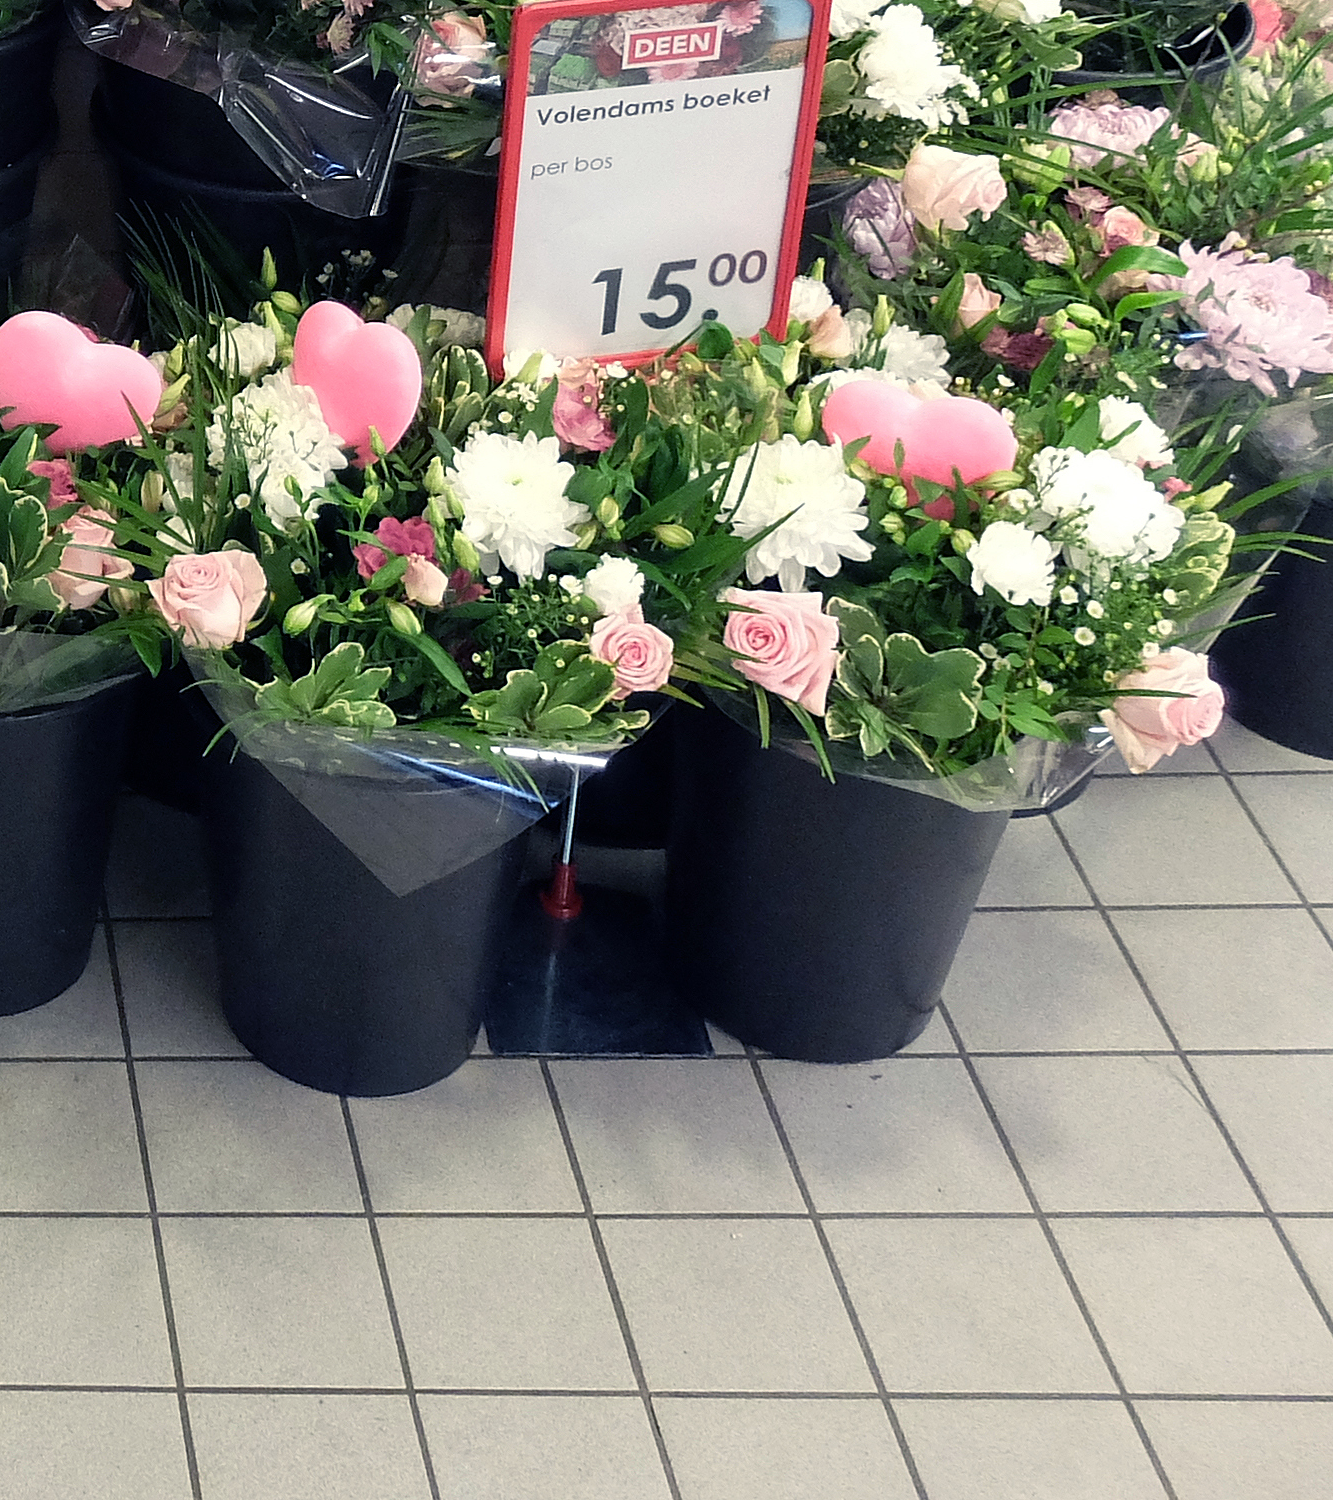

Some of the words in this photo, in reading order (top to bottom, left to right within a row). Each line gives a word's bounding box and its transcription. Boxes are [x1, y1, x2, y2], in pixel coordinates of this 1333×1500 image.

[634, 32, 712, 59] DEEN
[537, 100, 675, 126] Volendams
[683, 85, 771, 110] boeket
[530, 160, 569, 180] per
[575, 156, 613, 173] bos
[592, 250, 768, 335] 15.00
